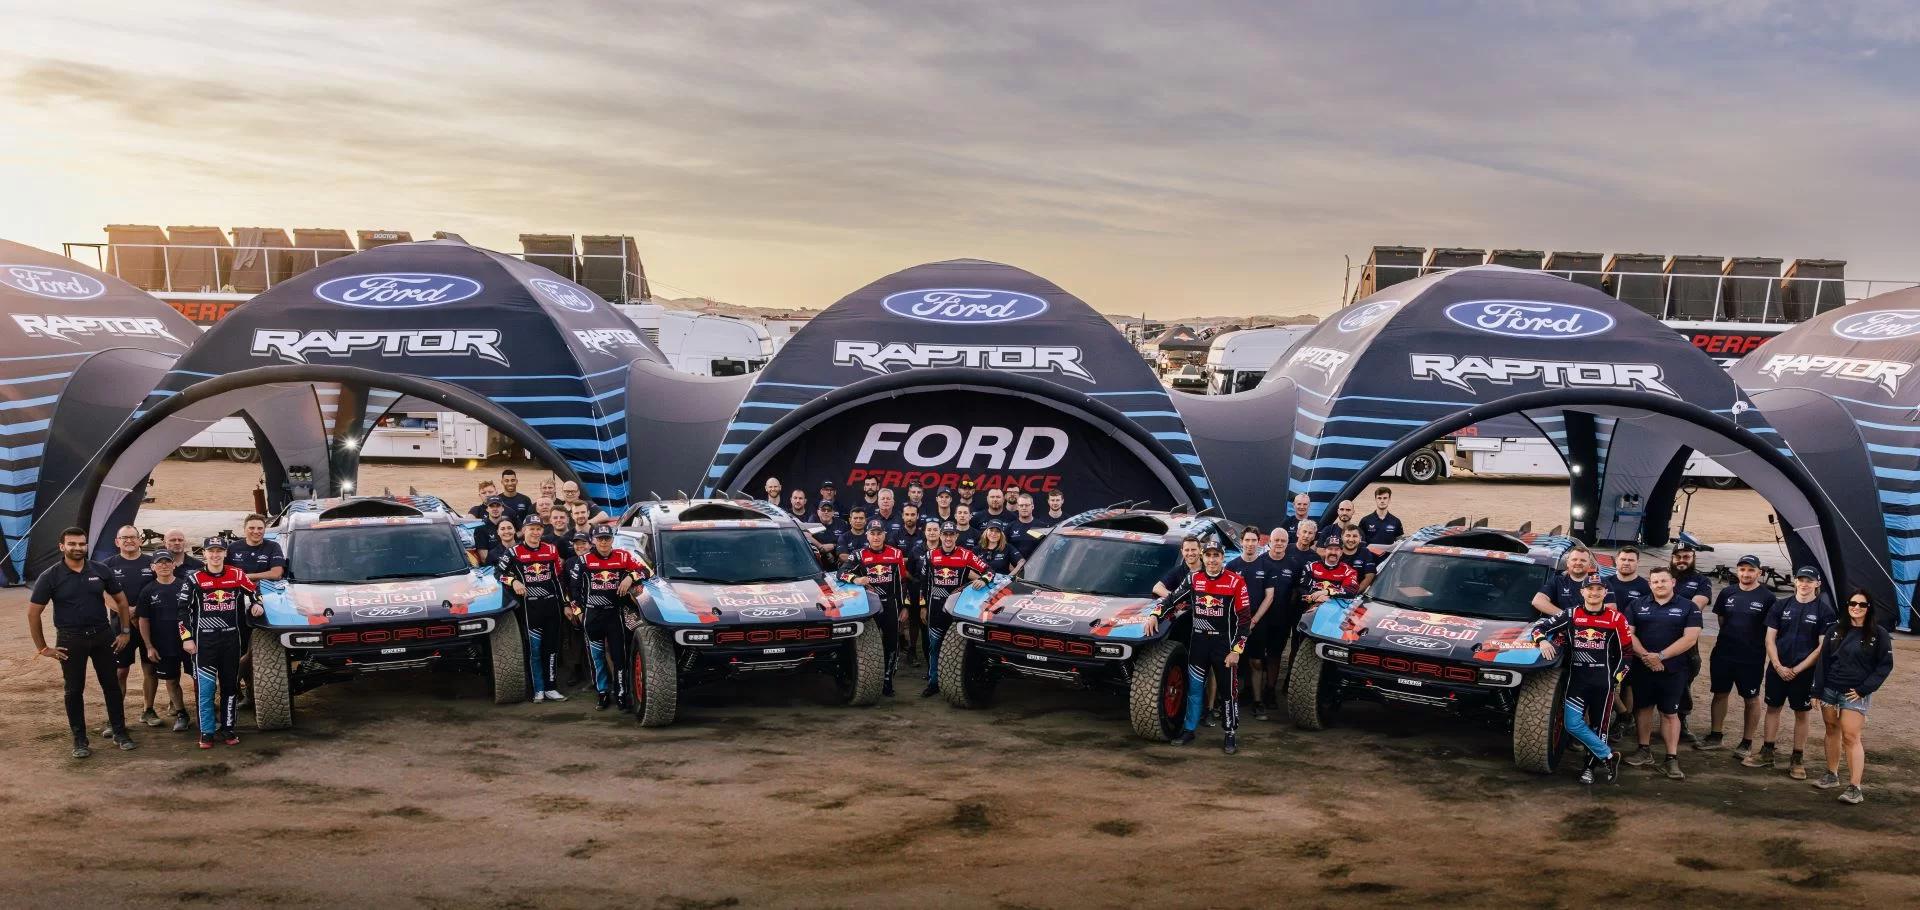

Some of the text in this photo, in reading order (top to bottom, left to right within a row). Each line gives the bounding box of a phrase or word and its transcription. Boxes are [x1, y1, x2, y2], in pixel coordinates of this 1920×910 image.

[9, 268, 90, 295] Ford
[343, 276, 454, 302] Ford
[912, 292, 1018, 318] Ford
[1476, 303, 1583, 333] Ford
[8, 313, 190, 346] RAPTOR
[250, 328, 510, 368] RAPTOR
[572, 328, 655, 359] RAPTOR
[833, 340, 1096, 384] RAPTOR
[1409, 353, 1683, 401] RAPTOR
[1758, 353, 1914, 398] RAPTOR
[854, 422, 1069, 470] FORD
[368, 606, 411, 616] Ford
[752, 607, 789, 616] Ford
[1027, 613, 1063, 625] Ford
[327, 625, 456, 647] FORD
[716, 627, 830, 644] FORD
[1376, 618, 1478, 641] Red Bull
[1397, 636, 1436, 649] Ford
[988, 631, 1093, 655] FORD
[1352, 653, 1476, 682] FORD
